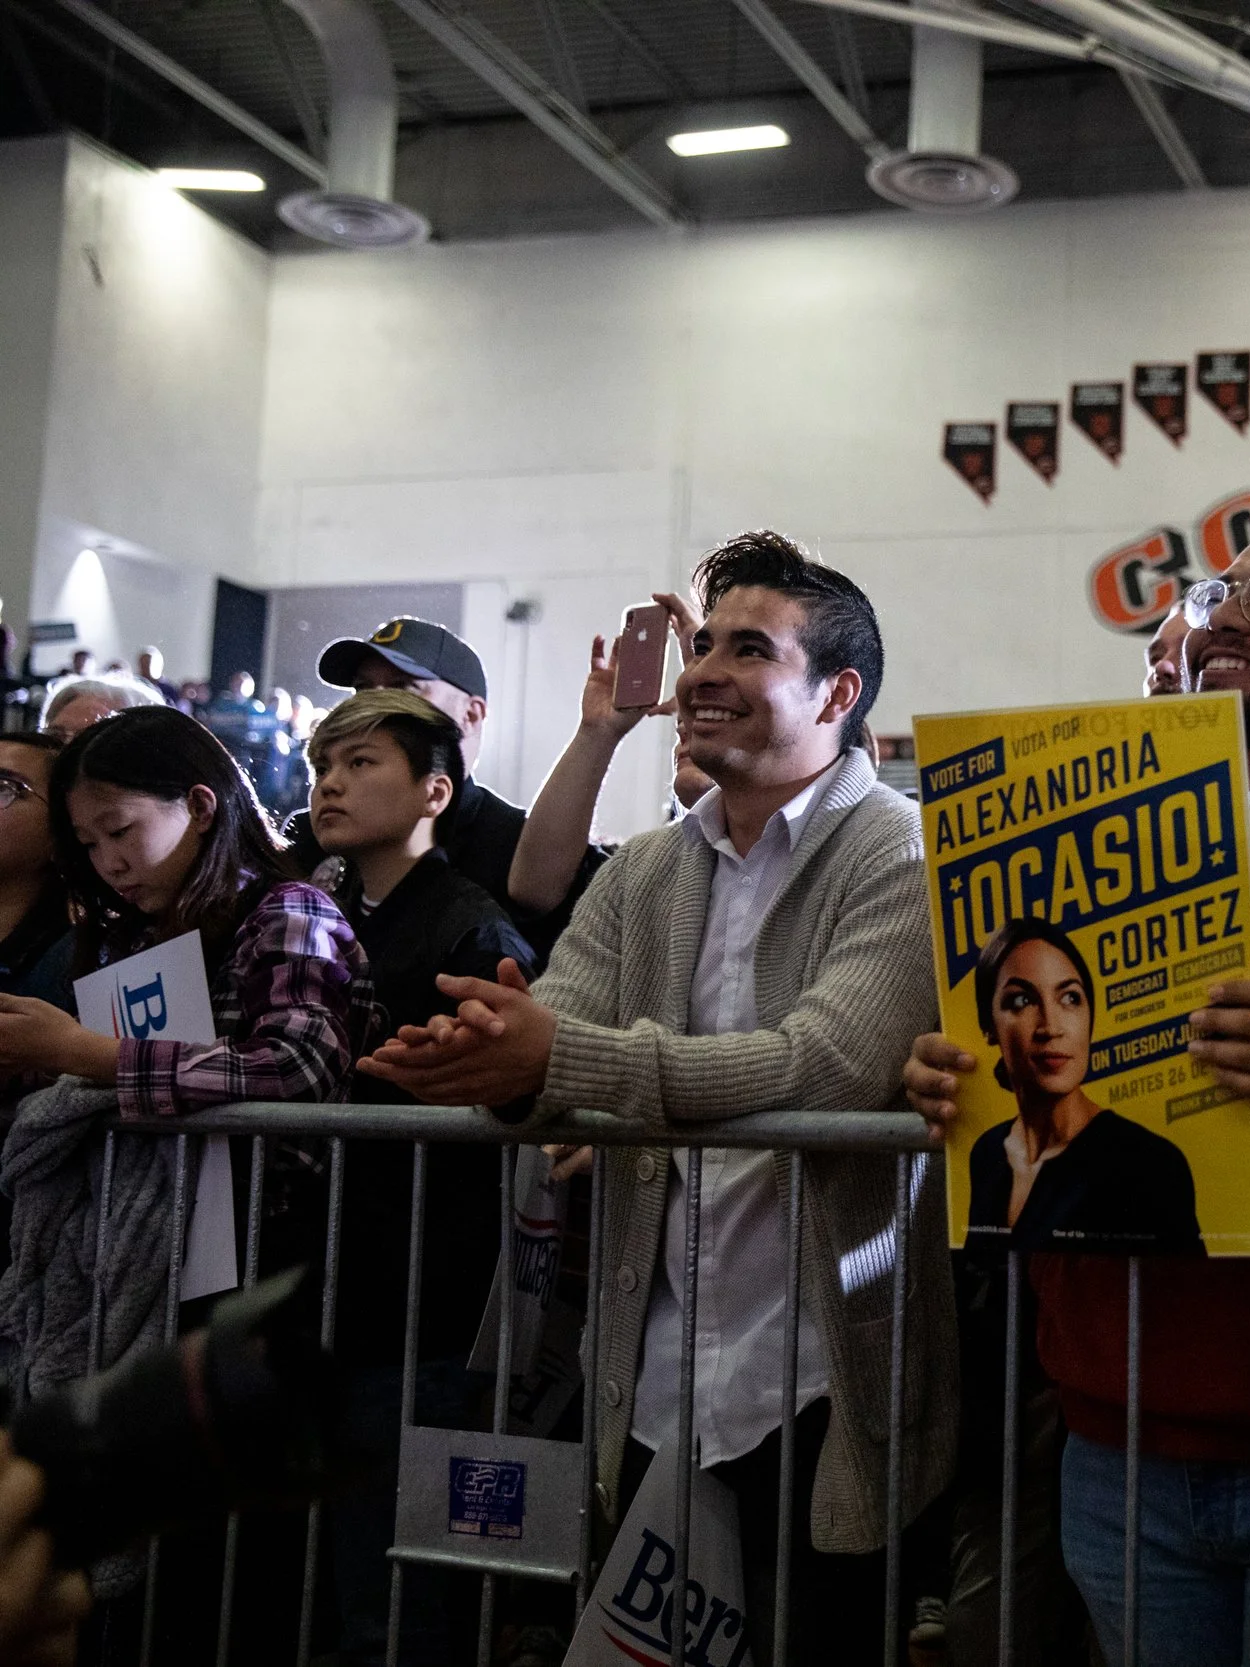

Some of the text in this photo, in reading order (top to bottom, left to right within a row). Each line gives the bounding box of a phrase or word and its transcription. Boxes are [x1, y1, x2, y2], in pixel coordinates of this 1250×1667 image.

[929, 761, 965, 792] VOTE
[968, 750, 996, 779] FOR
[1012, 729, 1047, 759] VOTA
[1052, 716, 1081, 745] POR
[936, 732, 1160, 855] ALEXANDRIA
[1099, 888, 1243, 977] CORTEZ
[1109, 972, 1165, 1001] DEMOCRAT
[1091, 1052, 1110, 1073] ON
[1114, 1027, 1176, 1064] TUESDAY
[1109, 1071, 1164, 1104] MARTES
[1168, 1066, 1186, 1086] 26
